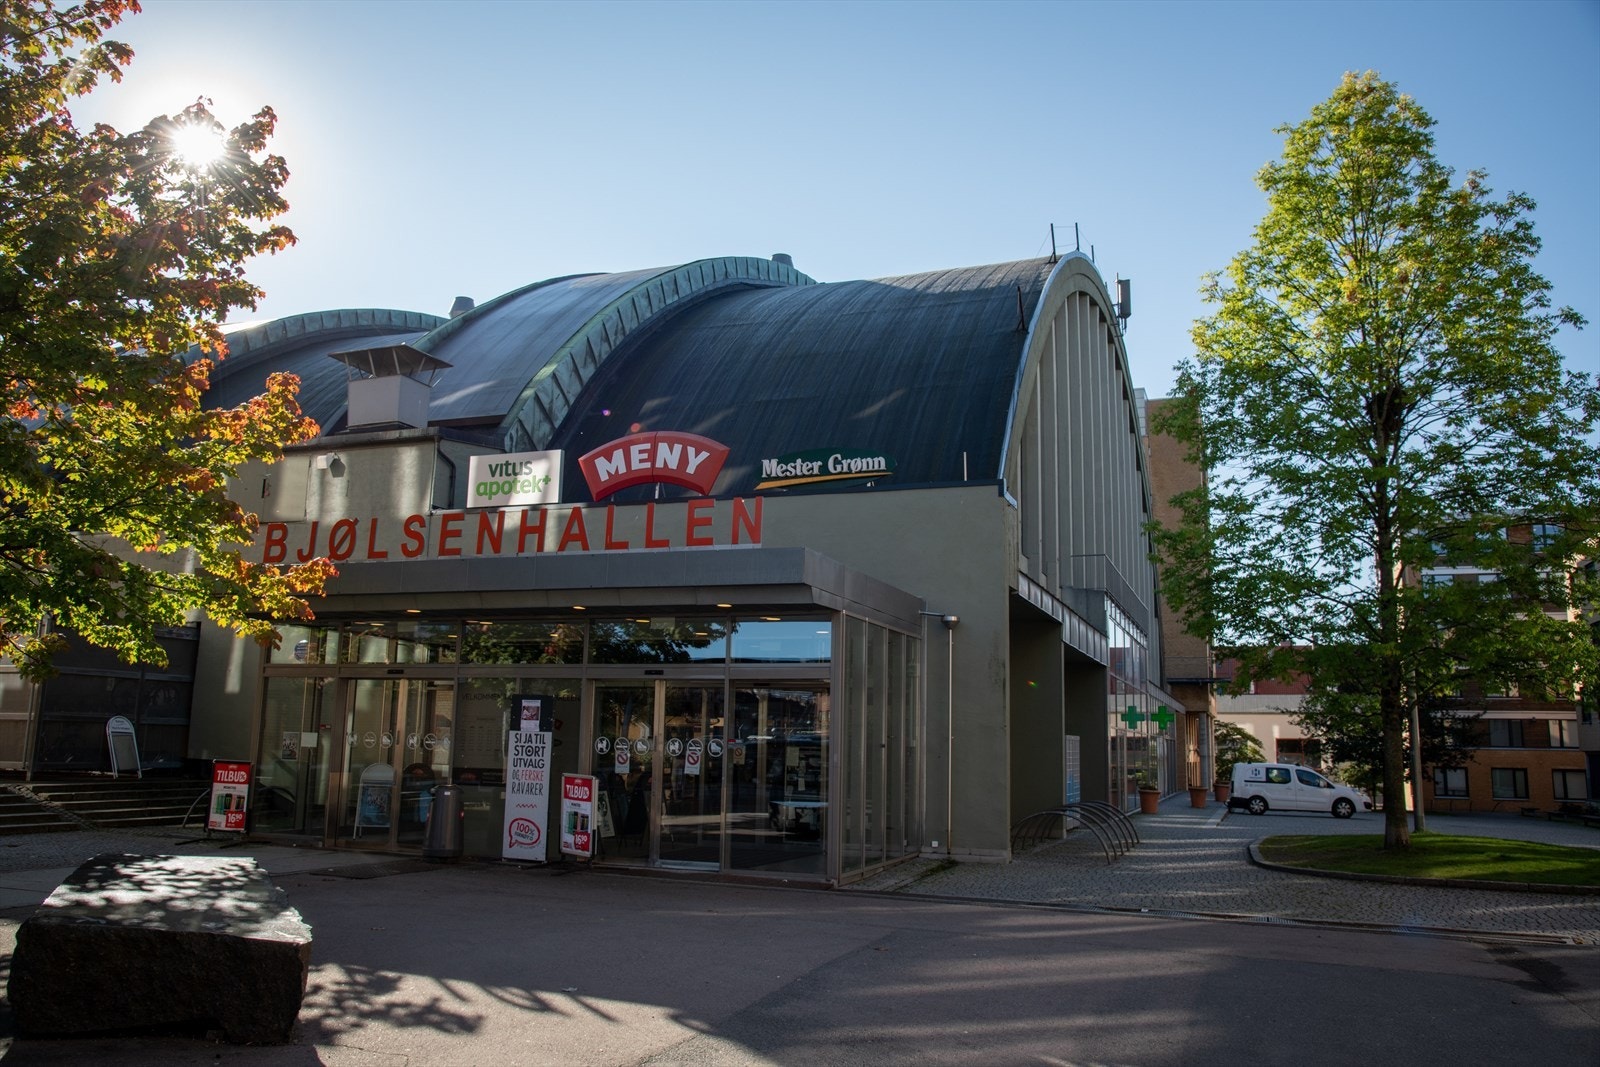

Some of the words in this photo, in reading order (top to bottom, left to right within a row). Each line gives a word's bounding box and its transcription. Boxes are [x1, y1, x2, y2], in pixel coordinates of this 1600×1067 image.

[488, 460, 533, 477] vitus
[594, 442, 711, 482] MENY
[761, 458, 823, 478] Mester
[827, 453, 887, 474] Grønn
[262, 496, 765, 564] BJØLSENHALLEN
[514, 732, 522, 744] SI
[523, 733, 533, 744] JA
[534, 733, 546, 745] TIL
[513, 745, 546, 758] STORT
[512, 757, 545, 769] UTVALG
[217, 770, 247, 782] TILBUD
[512, 769, 520, 780] OG
[521, 769, 544, 782] FERSKE
[516, 822, 535, 836] 100%
